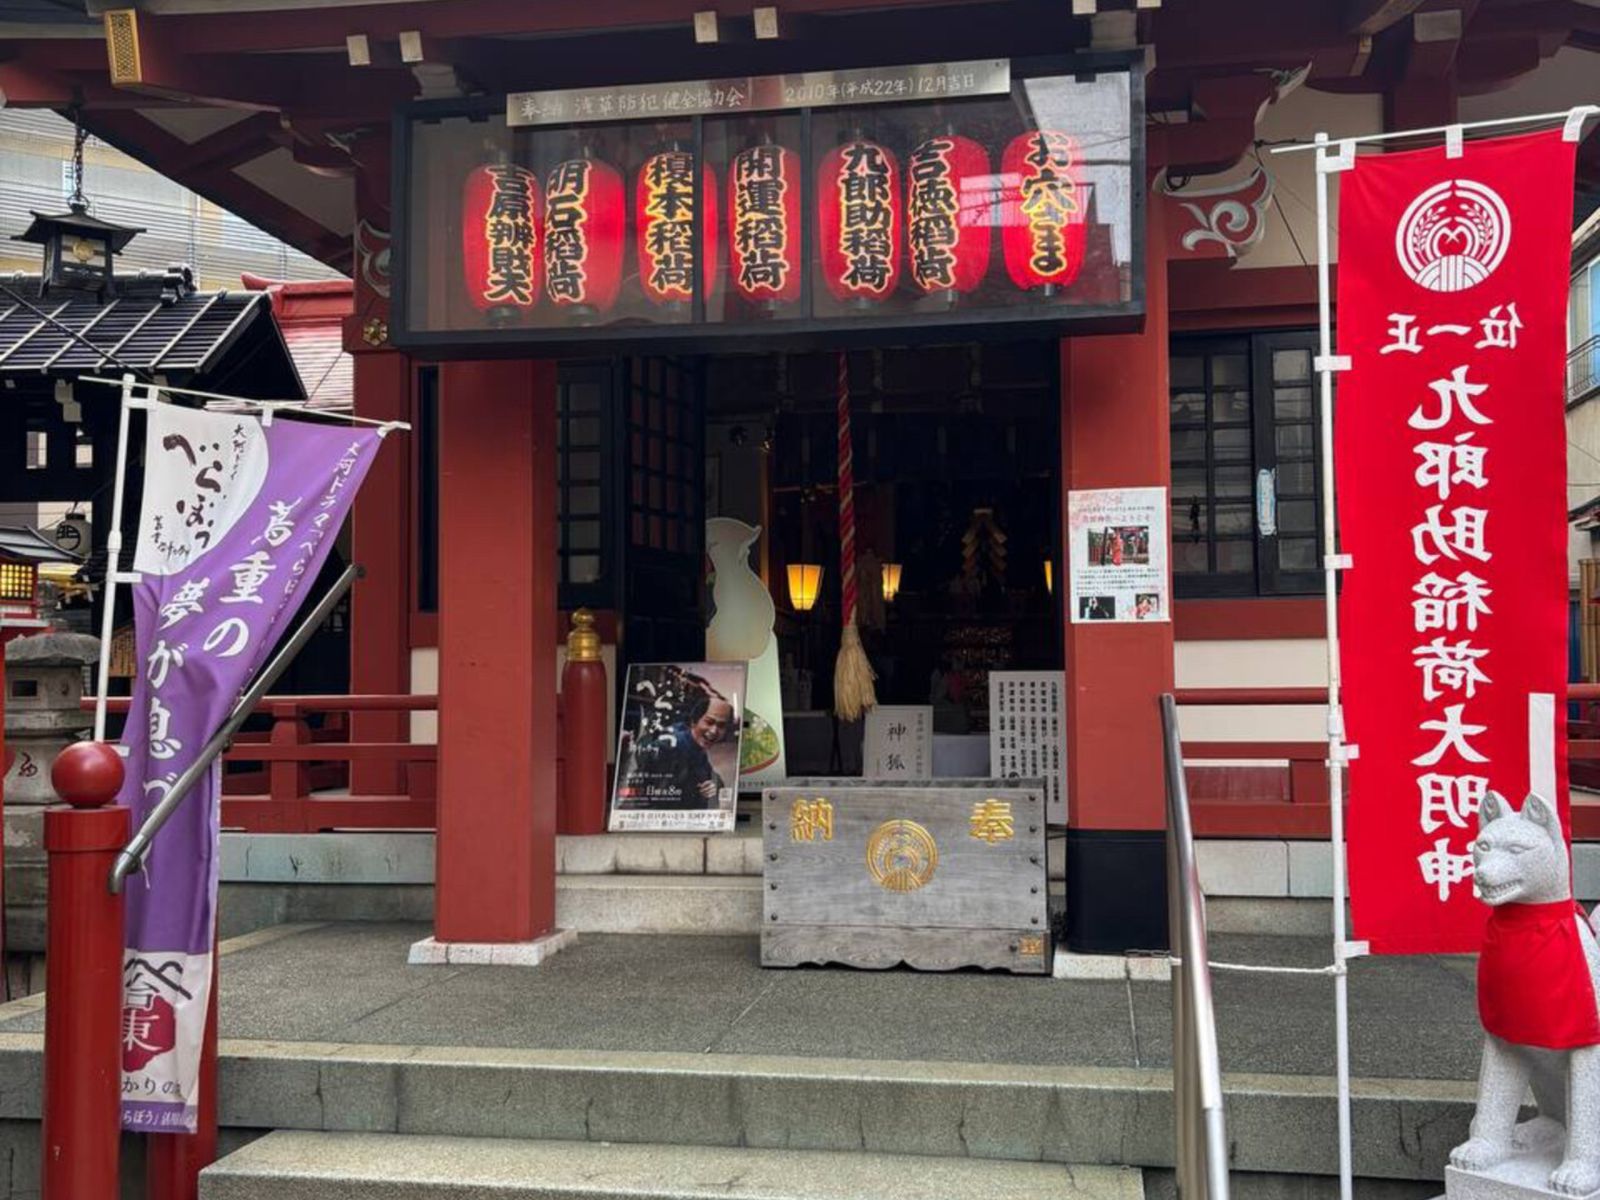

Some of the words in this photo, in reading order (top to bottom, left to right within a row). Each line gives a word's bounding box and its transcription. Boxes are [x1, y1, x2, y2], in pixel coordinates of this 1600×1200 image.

[545, 160, 592, 301] 明石稲荷
[646, 152, 693, 294] 榎本稲荷
[736, 146, 788, 291] 開運稲荷
[840, 144, 893, 292] 九郎助稲荷
[908, 139, 960, 290] 吉徳稲荷
[1019, 132, 1077, 276] お穴さま
[163, 434, 226, 548] べらぼう
[790, 798, 834, 842] 納
[970, 798, 1015, 845] 奉
